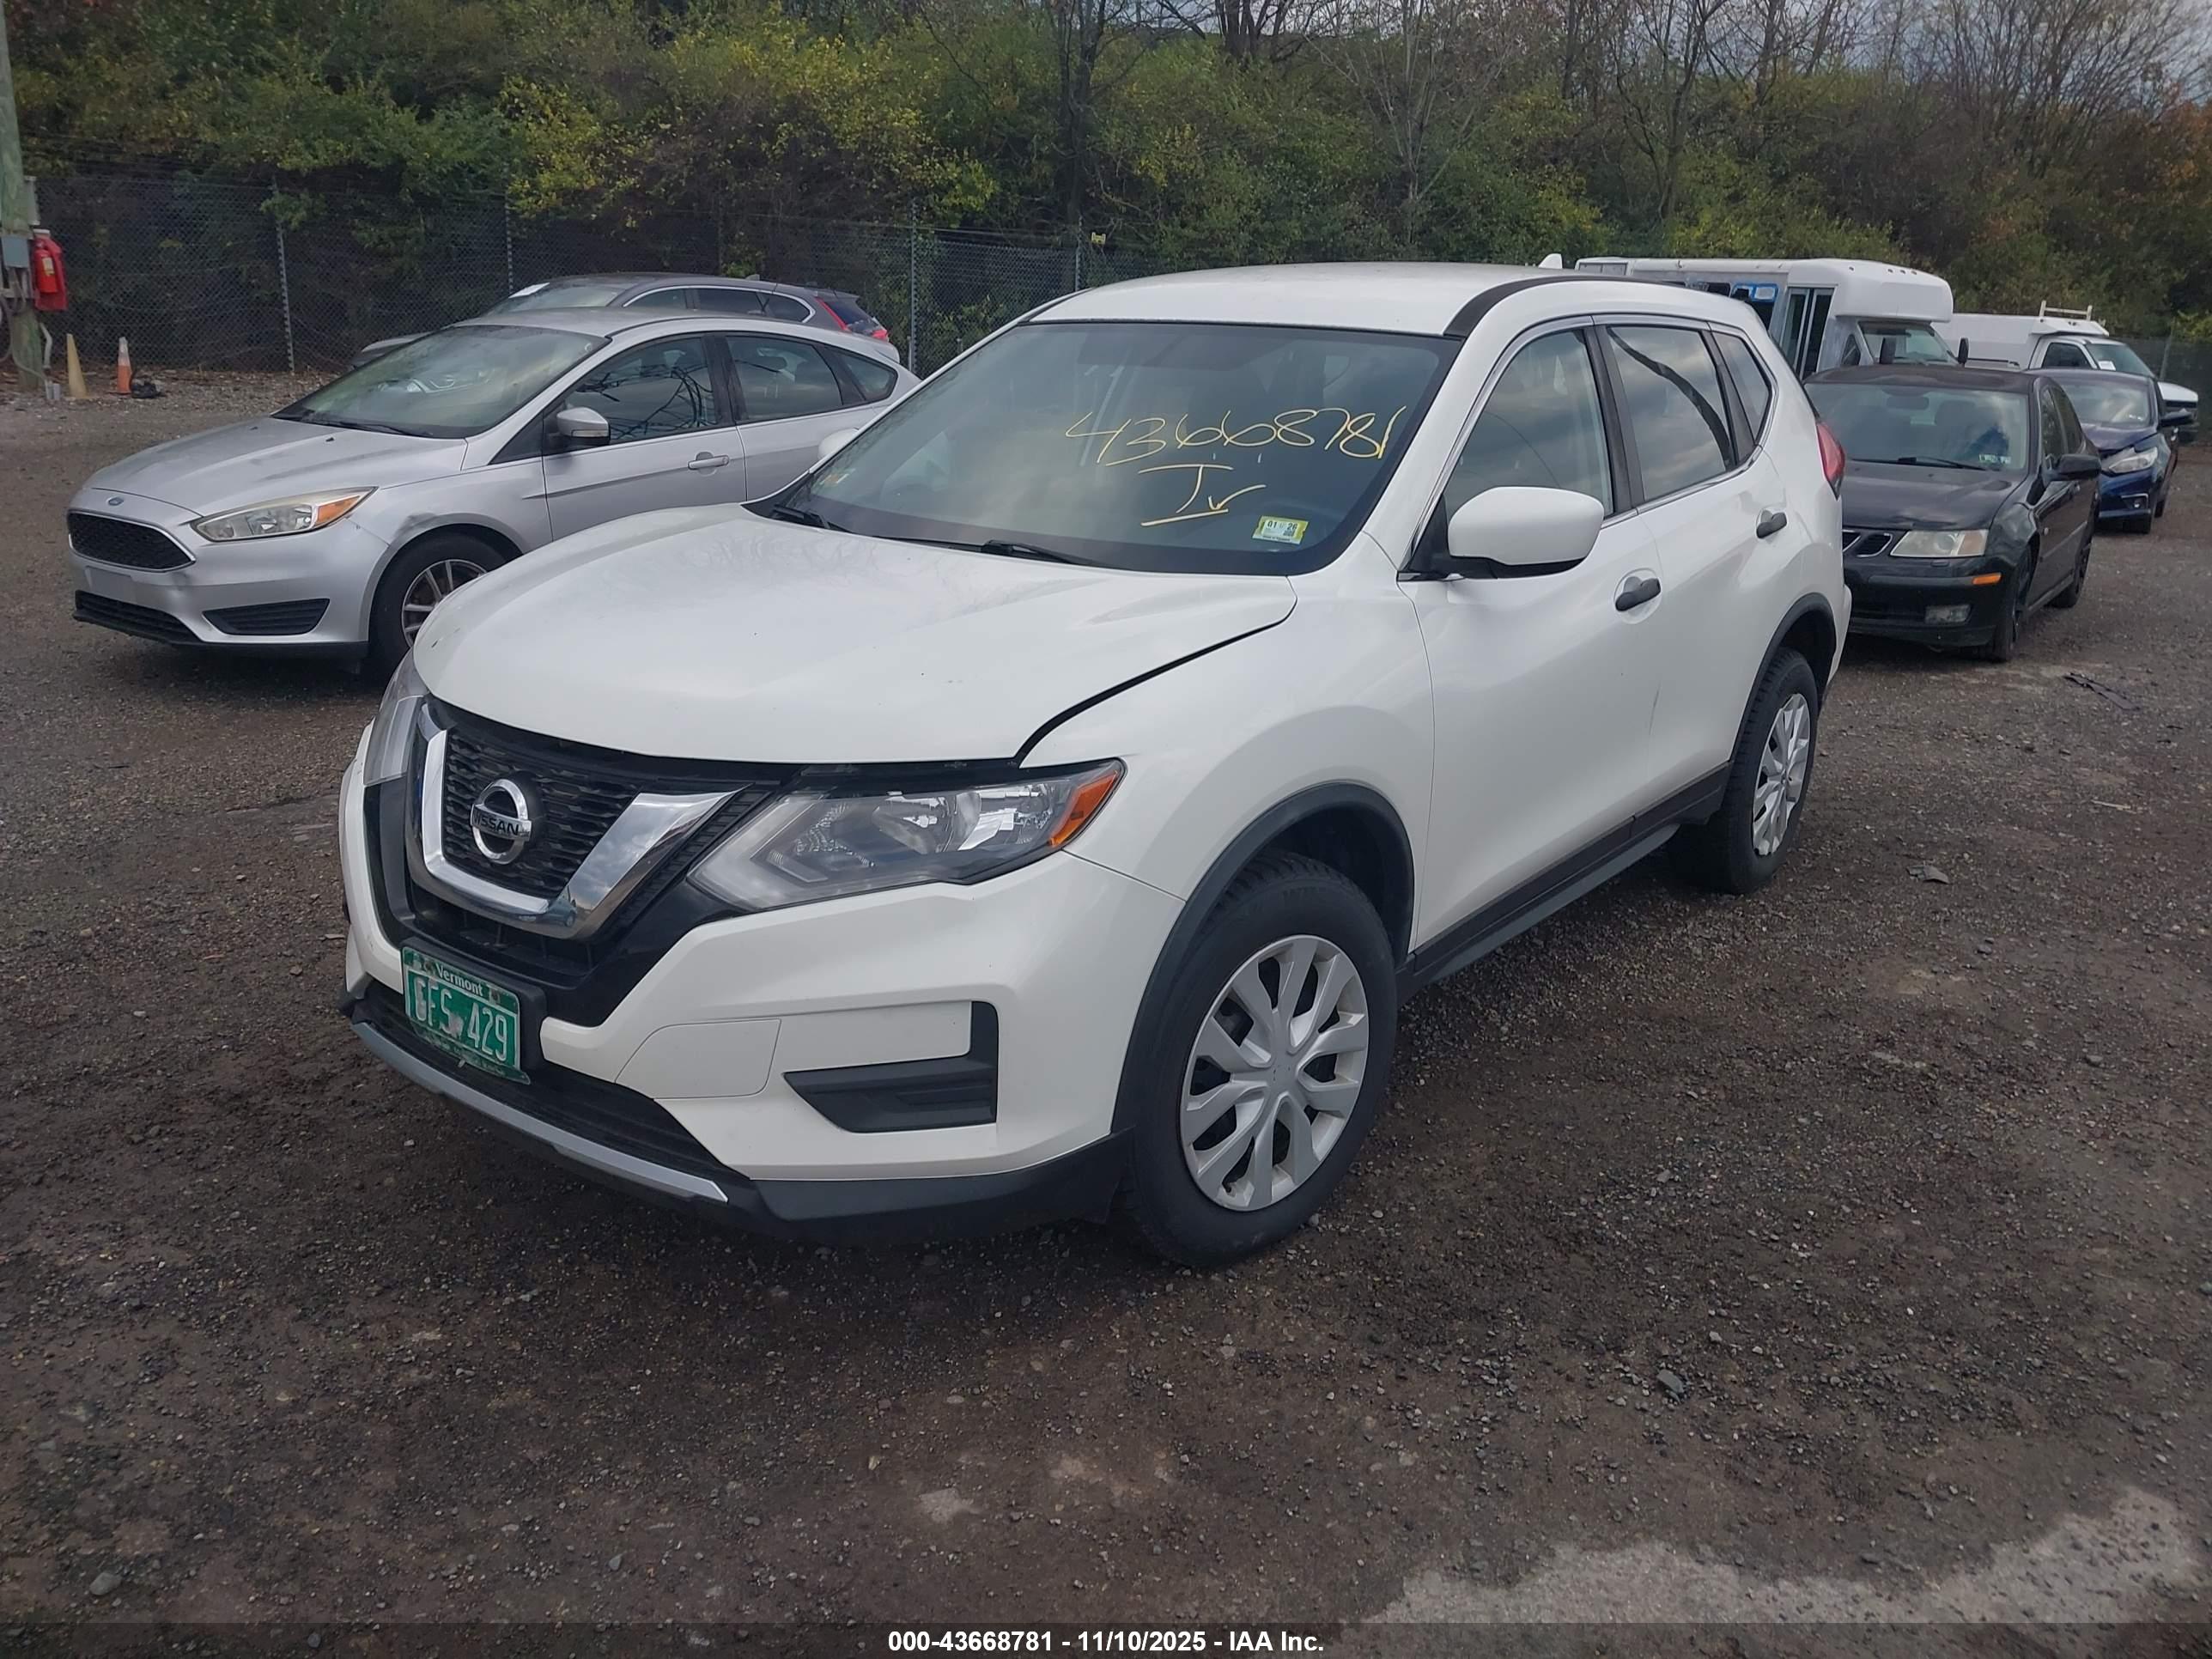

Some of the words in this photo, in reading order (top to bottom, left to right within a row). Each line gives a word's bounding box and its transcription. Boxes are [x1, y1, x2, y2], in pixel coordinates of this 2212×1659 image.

[1065, 405, 1407, 466] 43668781
[473, 811, 520, 836] NISSAN
[434, 962, 483, 996] Vermont
[467, 1002, 507, 1061] 429
